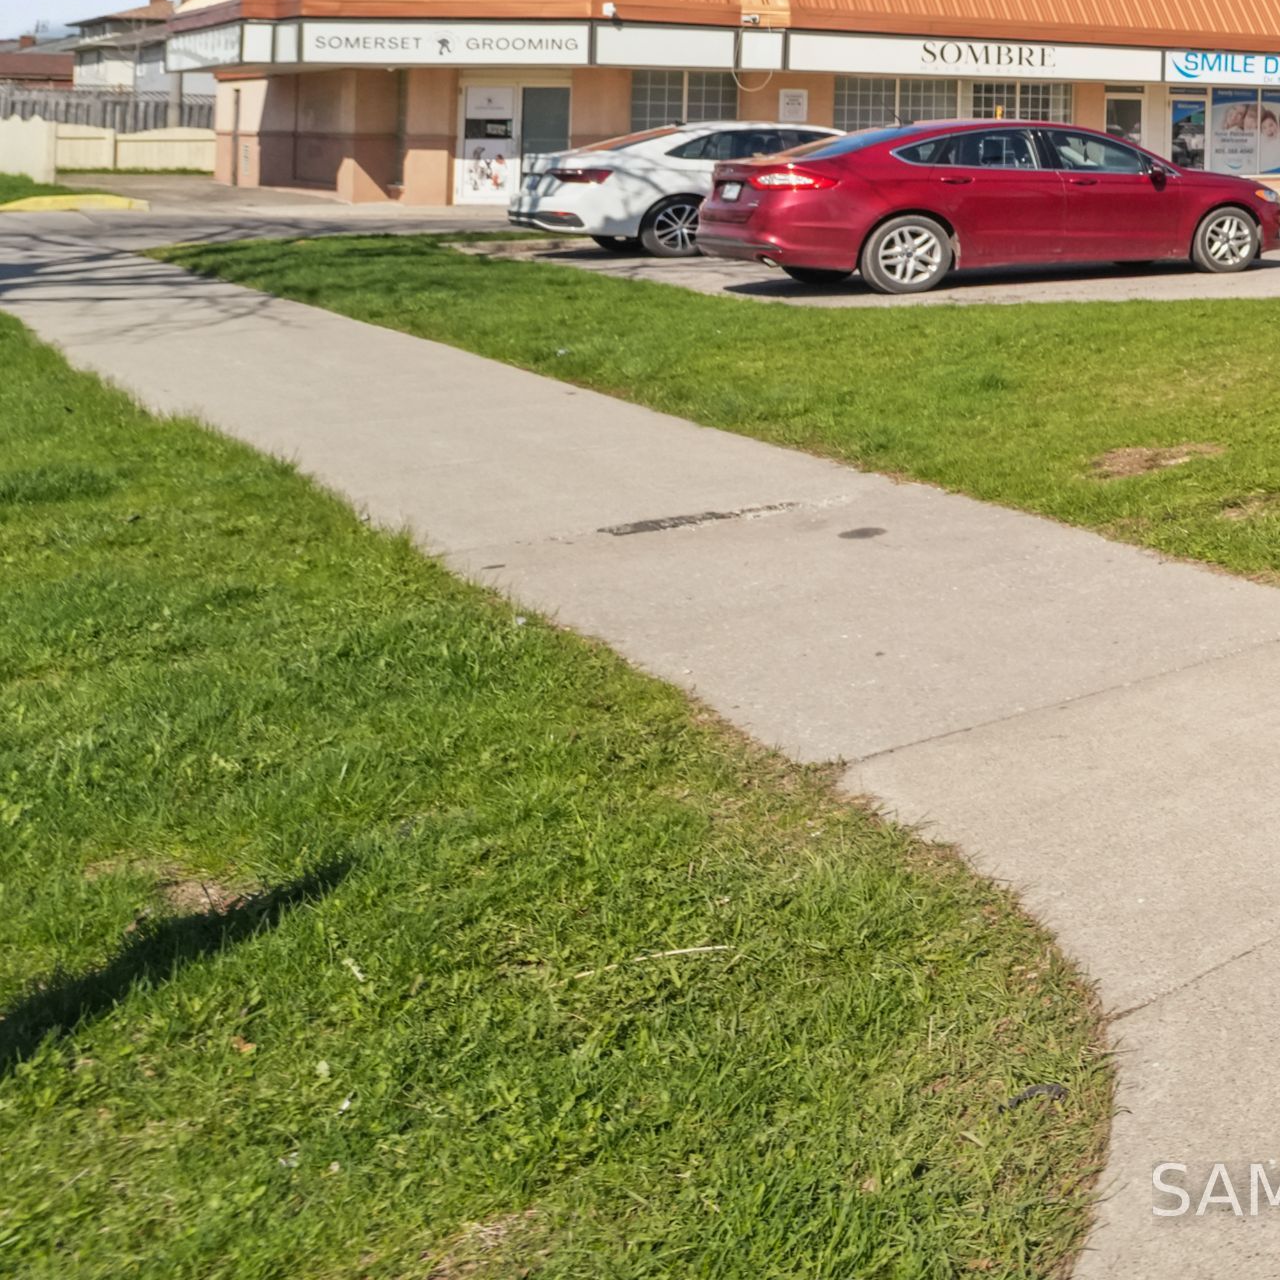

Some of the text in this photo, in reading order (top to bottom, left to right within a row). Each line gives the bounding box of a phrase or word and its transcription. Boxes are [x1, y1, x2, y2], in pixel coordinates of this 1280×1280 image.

[315, 35, 579, 51] SOMERSET GROOMING
[921, 41, 1056, 67] SOMBRE
[1185, 52, 1255, 73] SMILE
